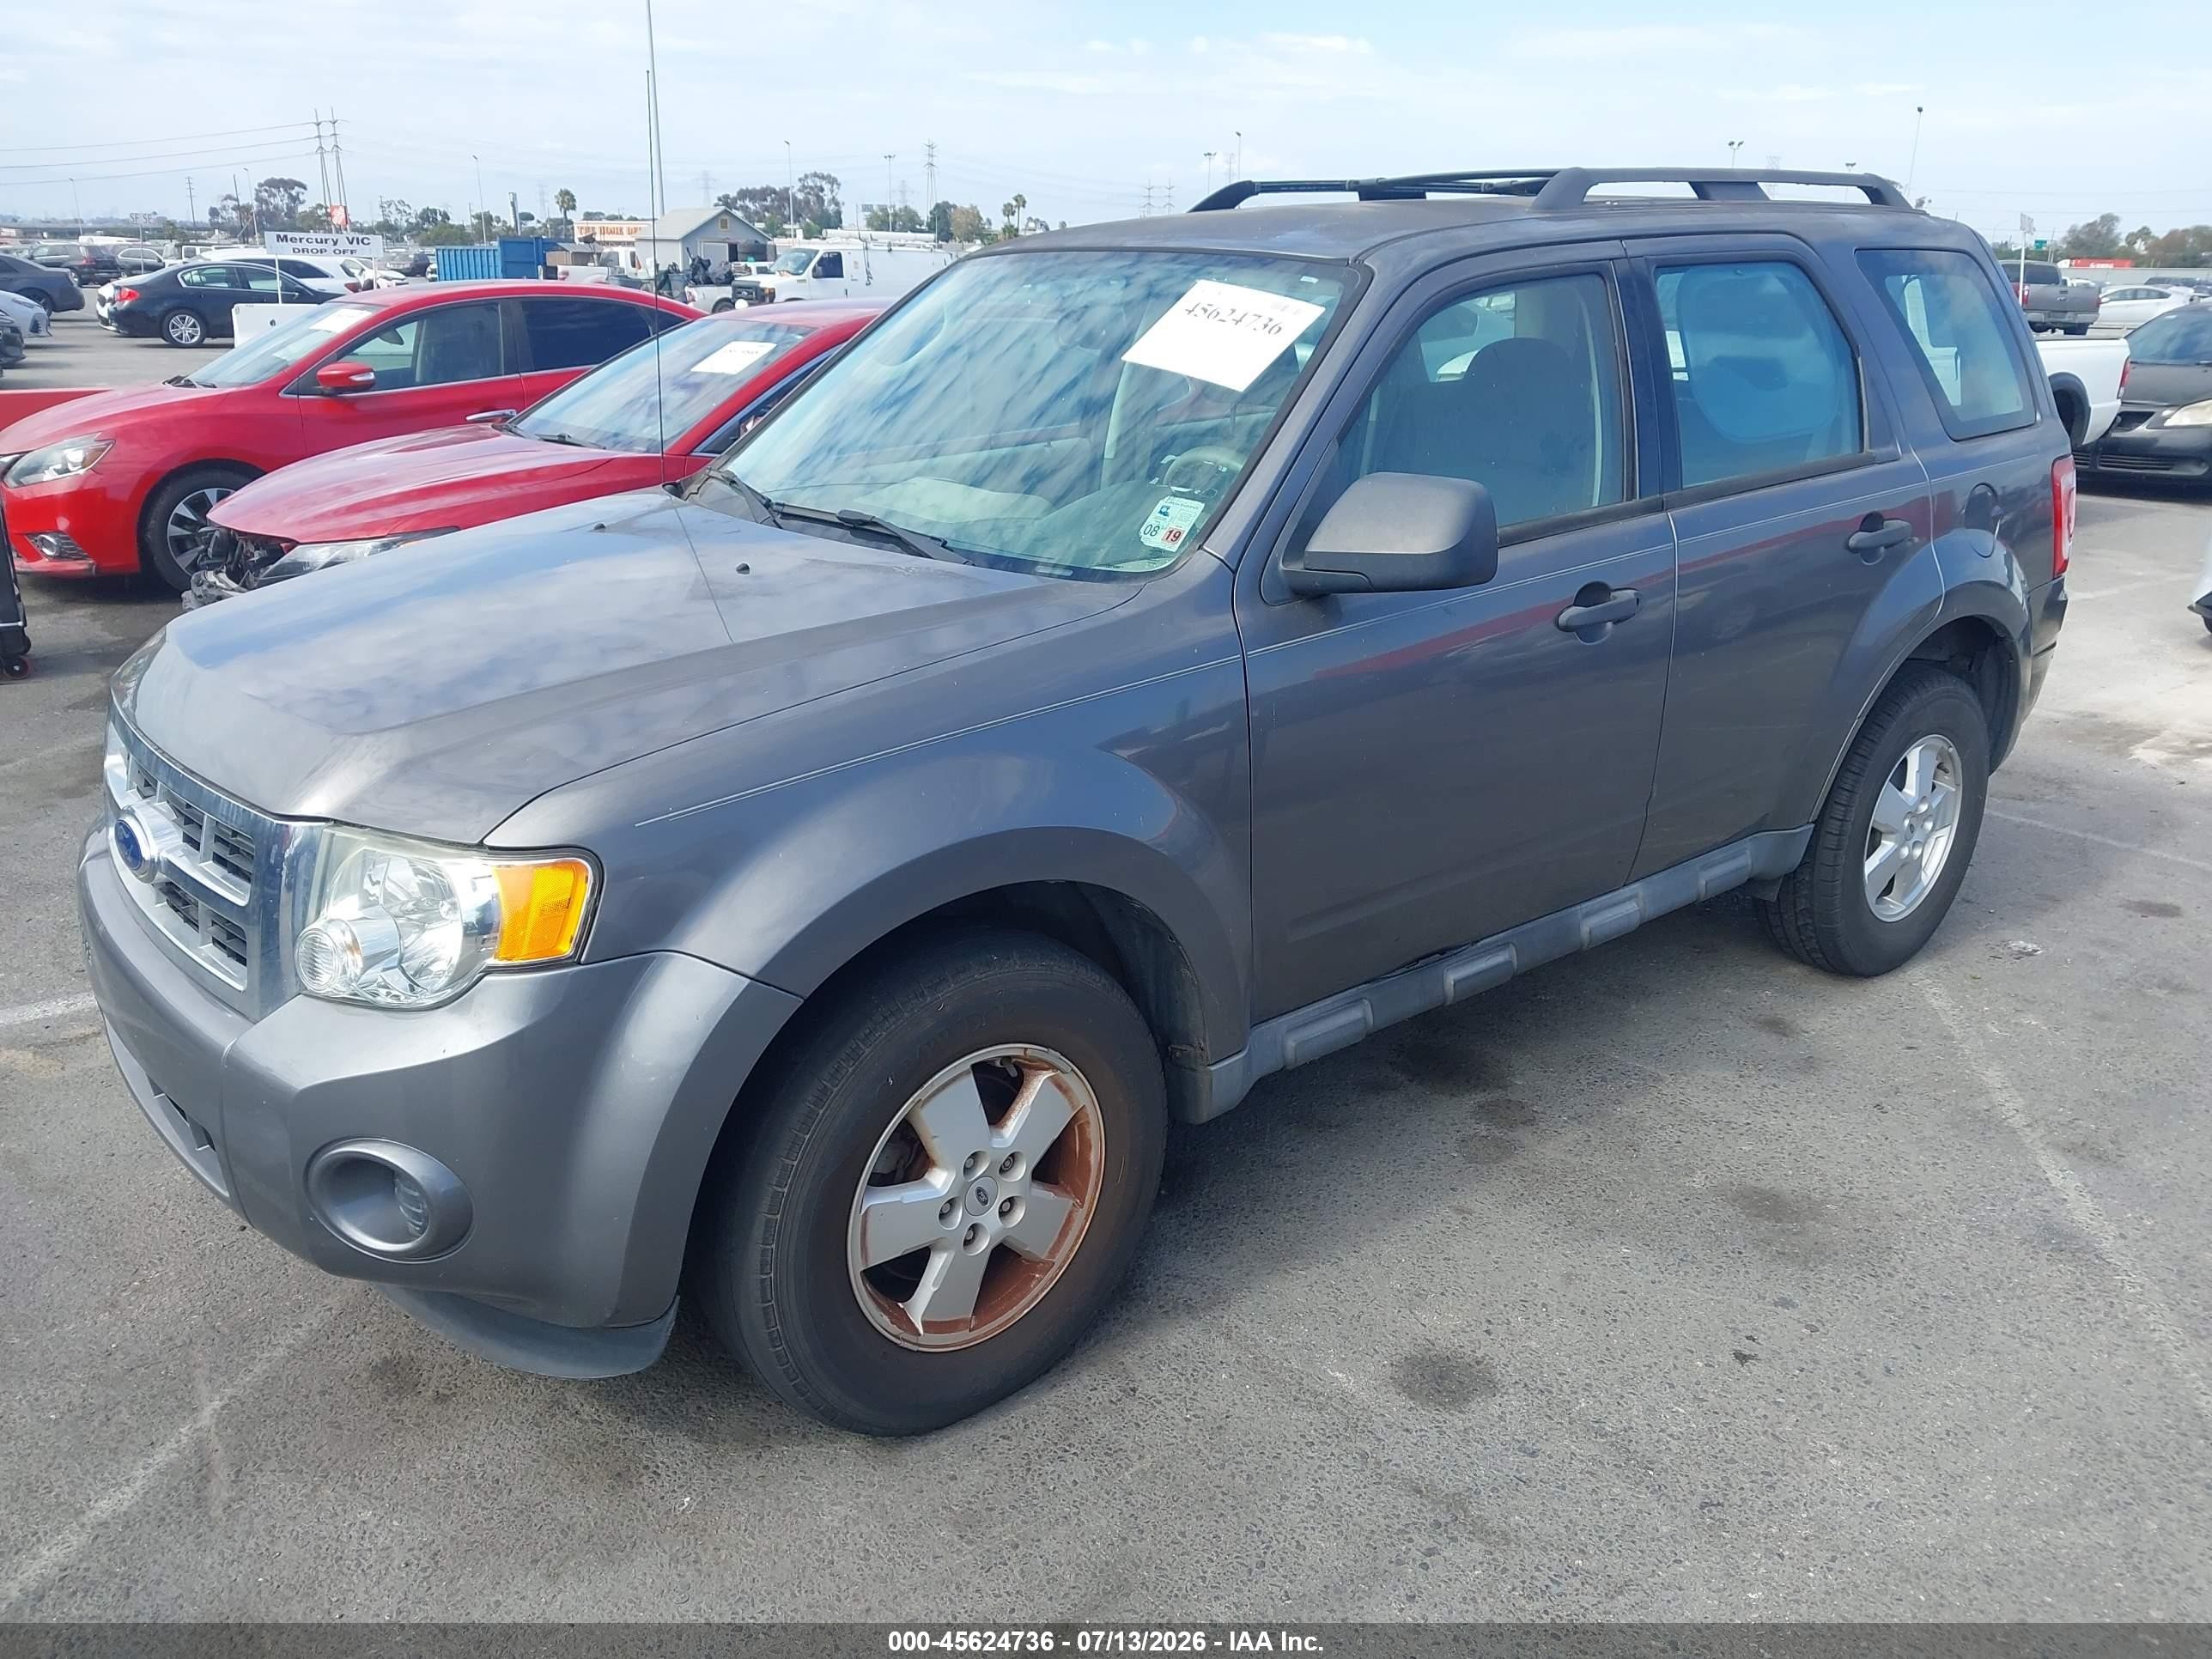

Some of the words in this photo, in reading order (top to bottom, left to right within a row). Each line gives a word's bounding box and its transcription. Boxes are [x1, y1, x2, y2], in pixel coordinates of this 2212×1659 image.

[276, 234, 338, 246] Mercury
[345, 236, 372, 246] VIC
[1185, 301, 1283, 335] 45624736
[1143, 524, 1160, 537] 08
[1165, 529, 1182, 543] 19
